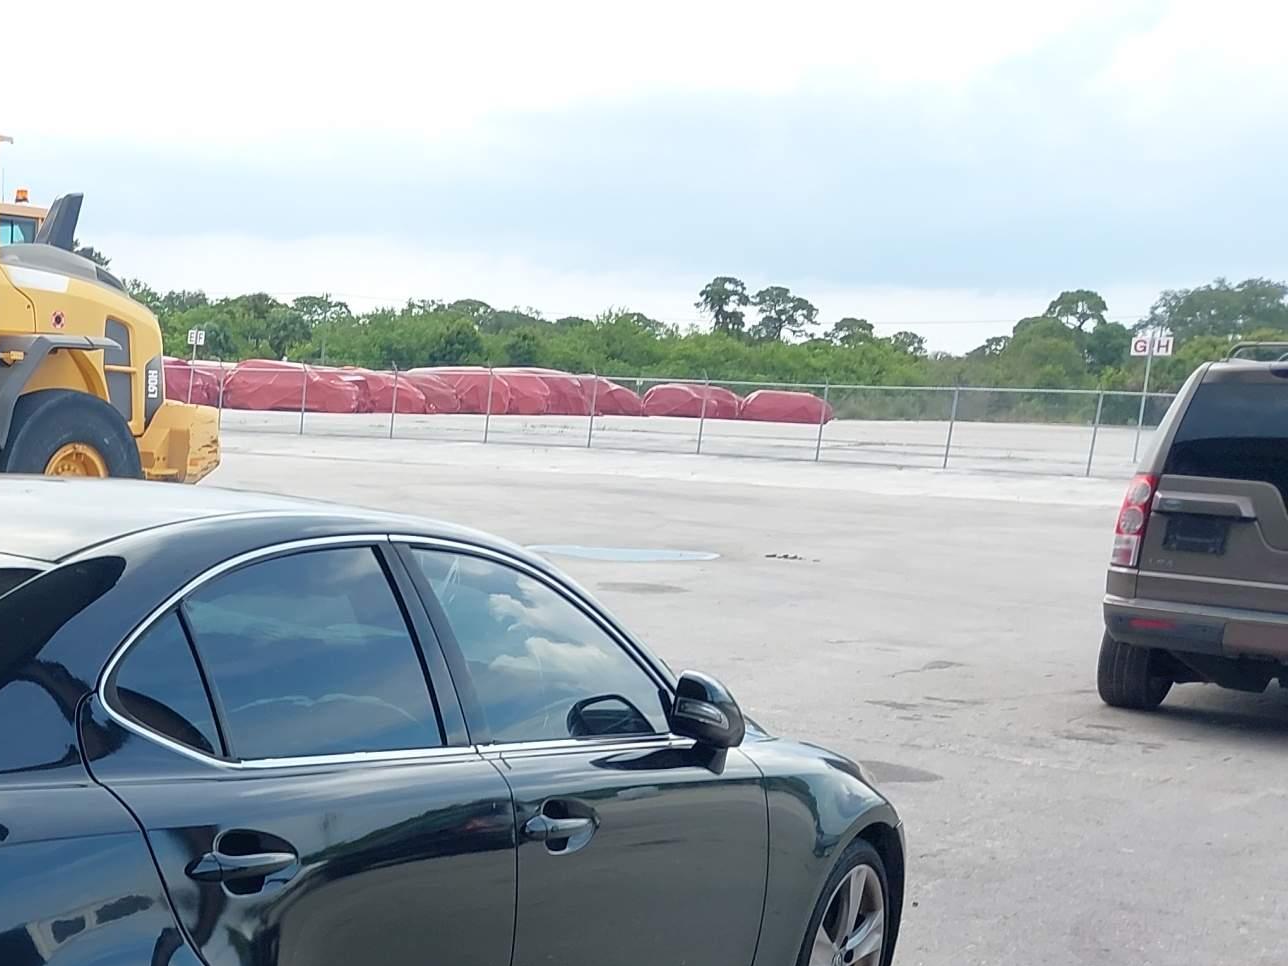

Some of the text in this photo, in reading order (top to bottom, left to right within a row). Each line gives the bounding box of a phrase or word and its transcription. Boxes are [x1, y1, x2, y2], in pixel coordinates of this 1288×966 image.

[1134, 339, 1147, 353] G
[1156, 339, 1170, 353] H
[147, 370, 158, 398] L90H
